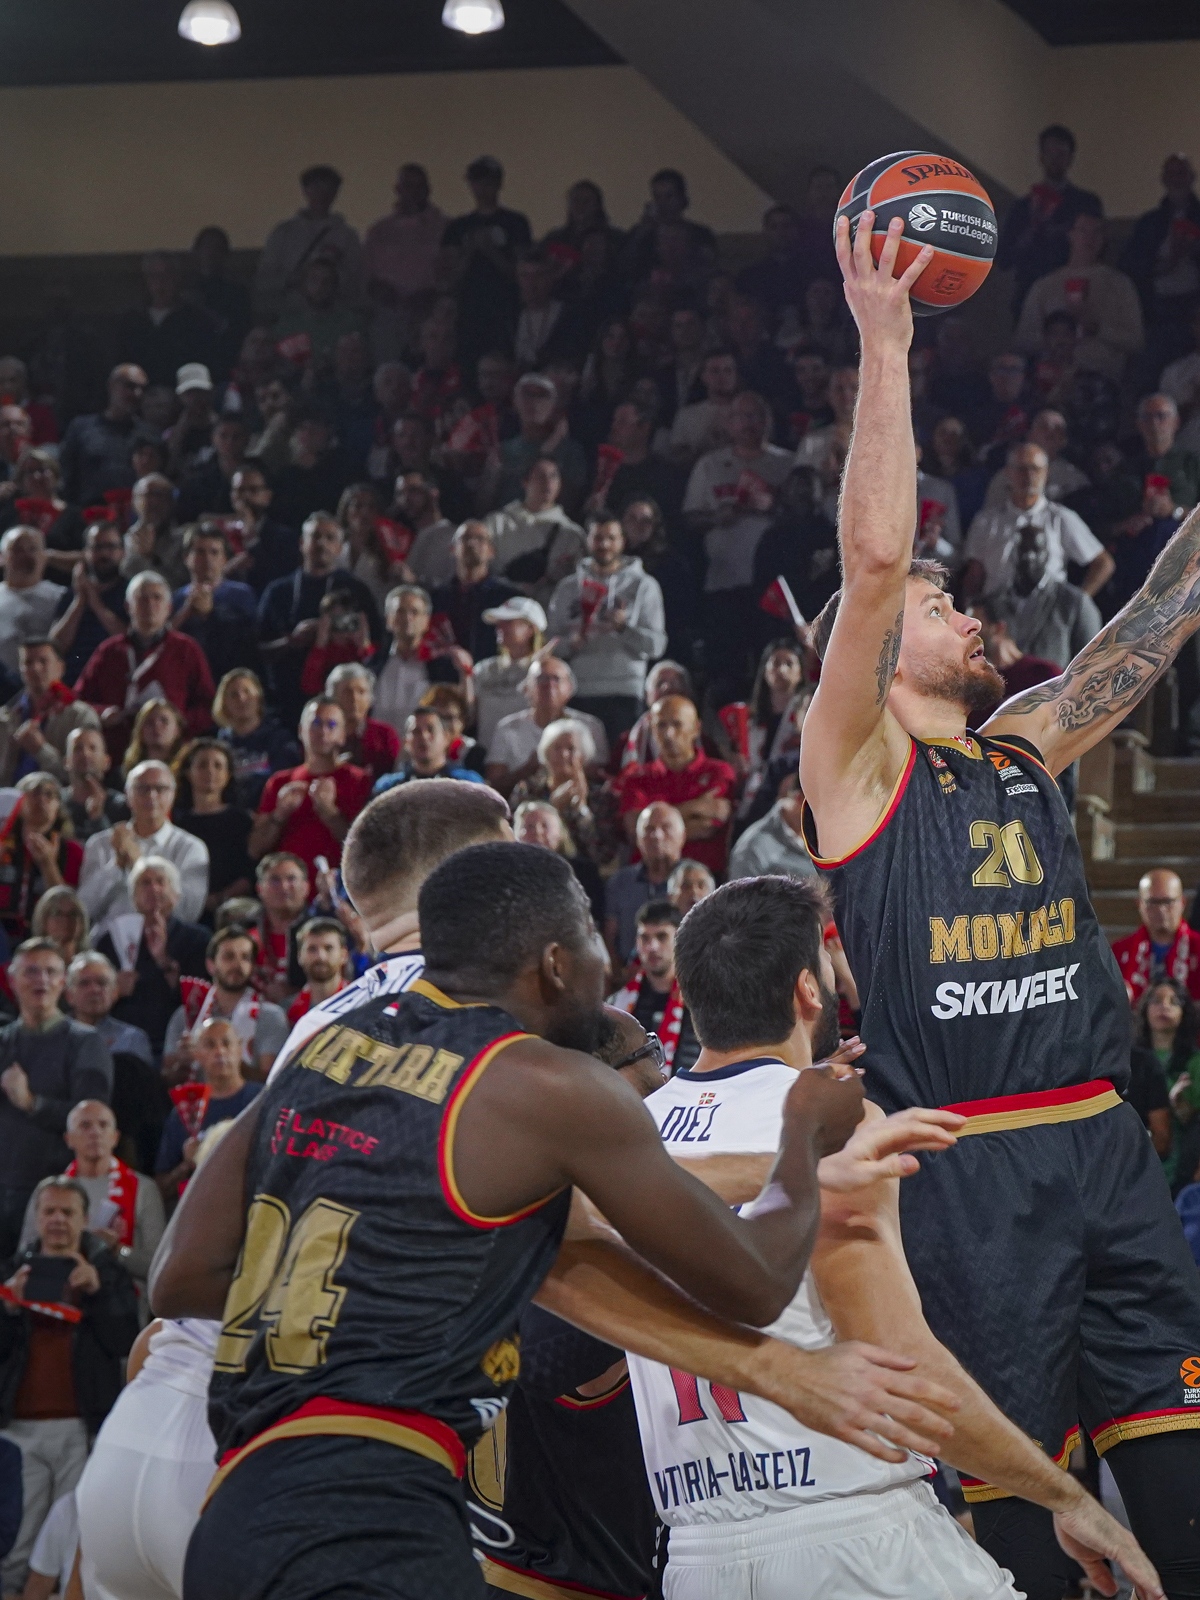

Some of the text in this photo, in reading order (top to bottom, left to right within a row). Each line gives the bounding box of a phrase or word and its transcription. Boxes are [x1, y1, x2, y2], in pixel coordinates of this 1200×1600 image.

[901, 164, 979, 186] SPALD
[940, 219, 994, 245] EuroLeague
[941, 209, 981, 227] TURKISH
[969, 819, 1044, 888] 20
[930, 962, 1081, 1020] SKWEEK
[292, 1113, 380, 1156] LATTICE
[660, 1102, 722, 1142] DIEZ
[213, 1193, 362, 1375] 24
